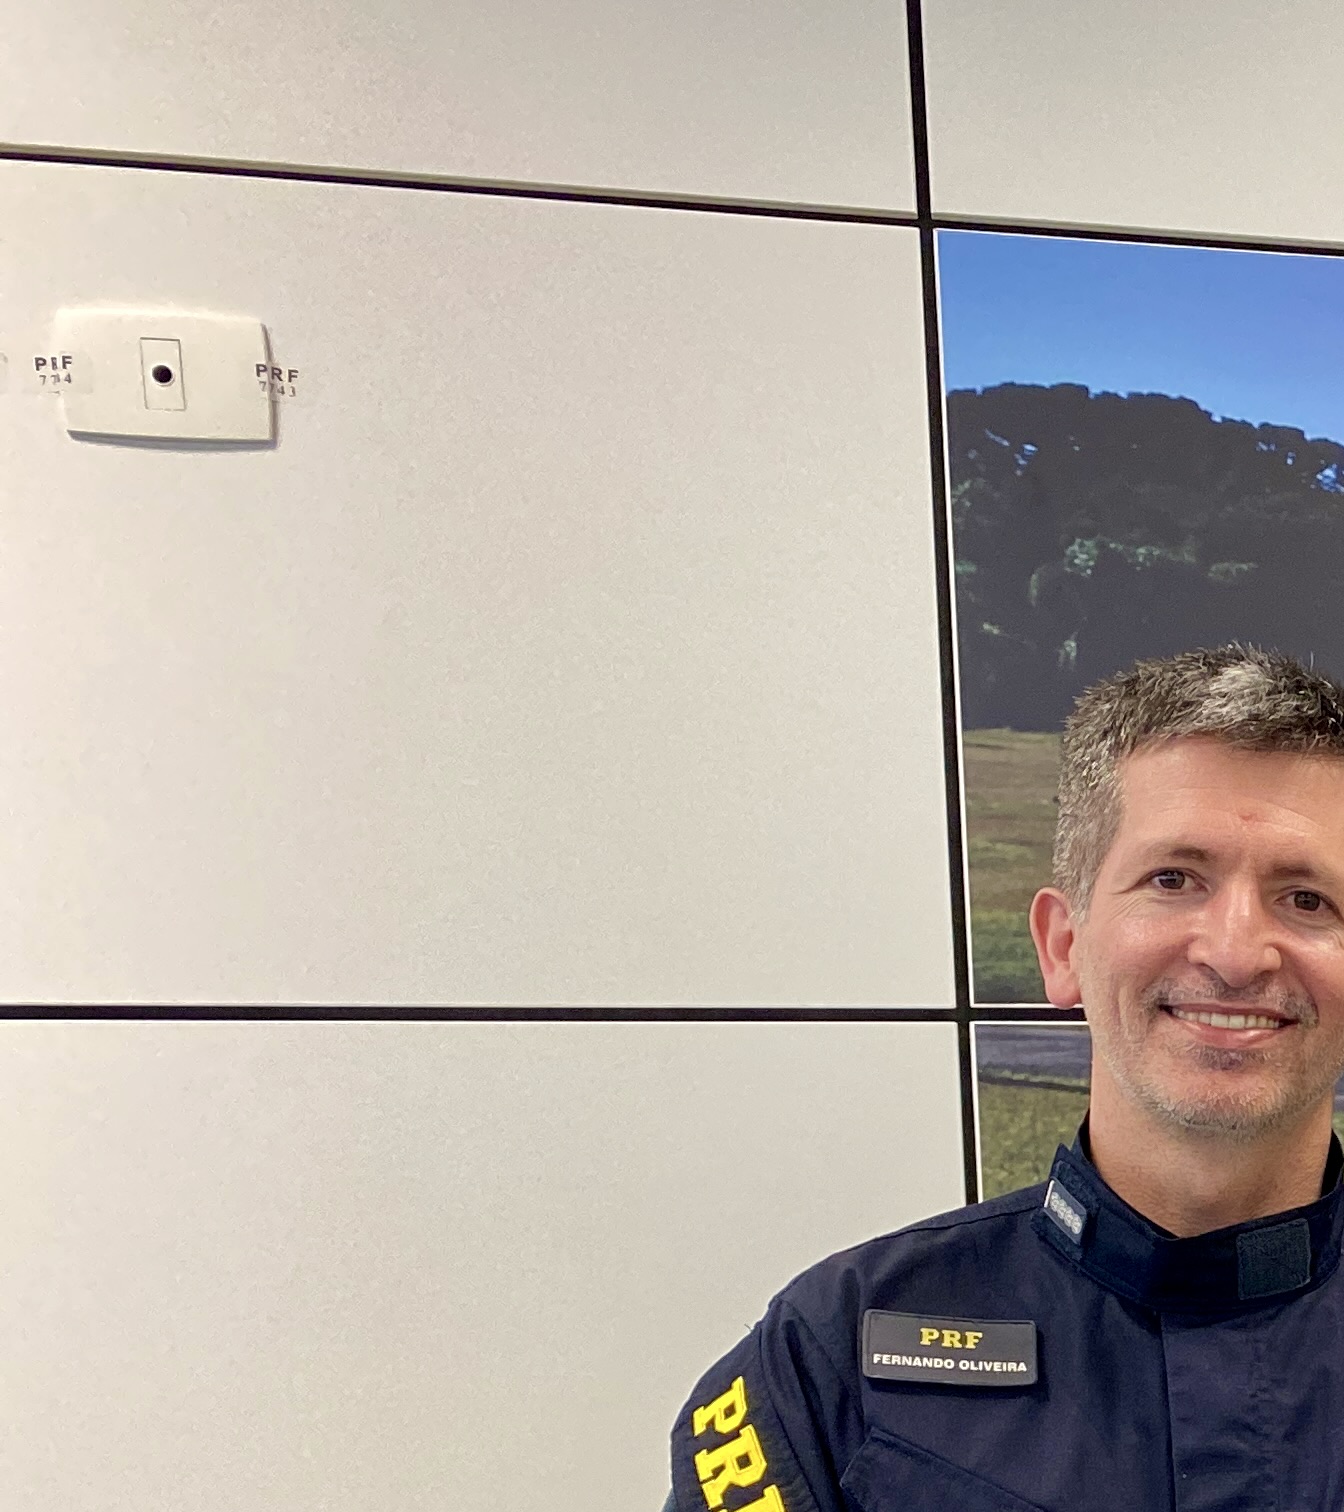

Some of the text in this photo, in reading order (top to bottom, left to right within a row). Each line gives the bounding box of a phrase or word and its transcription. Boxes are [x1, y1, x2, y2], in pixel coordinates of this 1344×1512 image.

[255, 363, 299, 383] PRF
[919, 1327, 983, 1350] PRF
[873, 1354, 1027, 1373] FERNANDO OLIVEIRA
